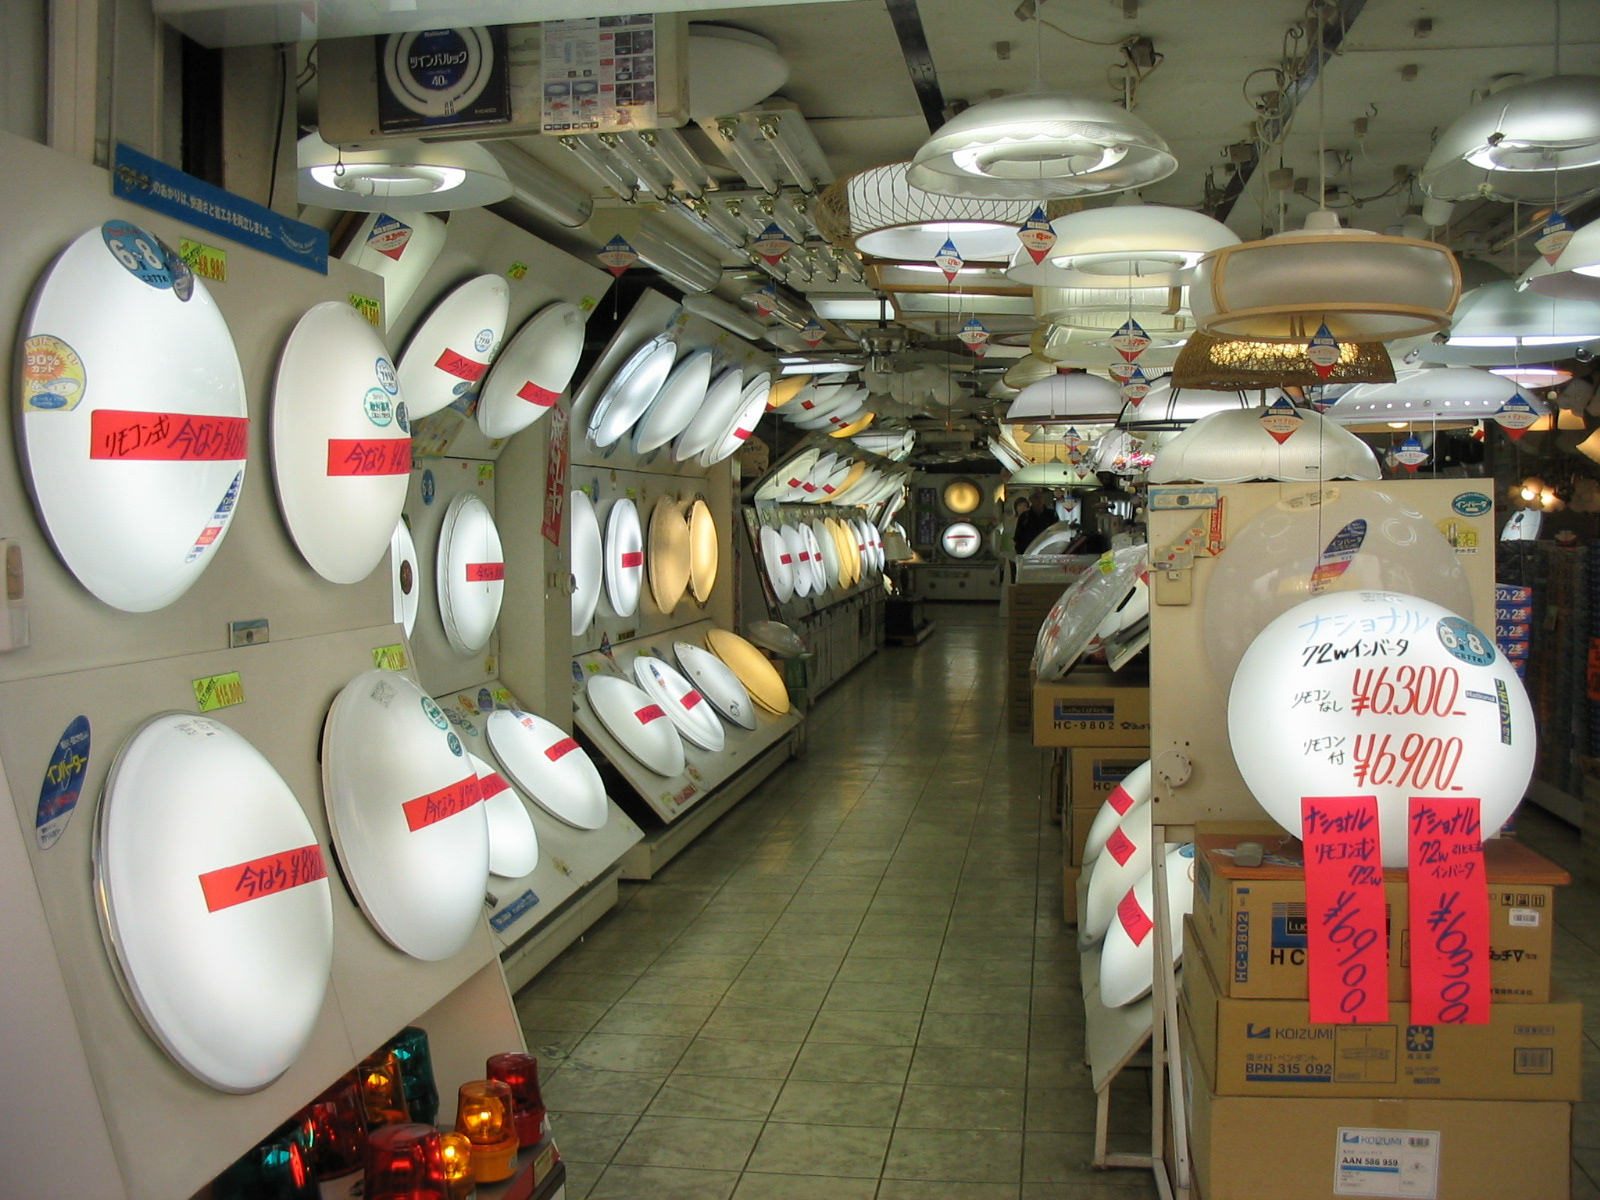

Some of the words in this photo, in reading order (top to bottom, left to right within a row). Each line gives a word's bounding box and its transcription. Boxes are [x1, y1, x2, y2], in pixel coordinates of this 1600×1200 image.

[1298, 606, 1430, 643] ナショナル
[1291, 688, 1332, 709] リモコン
[1318, 700, 1344, 713] なし
[1053, 721, 1115, 730] HC-9802
[1303, 736, 1347, 756] リモコン
[1327, 751, 1346, 766] 付
[1304, 805, 1374, 835] ナショナル
[1412, 804, 1481, 837] ナショナル
[1315, 837, 1376, 864] リモコン式
[235, 858, 288, 898] 今なら
[1431, 861, 1476, 880] インバータ
[1235, 913, 1248, 982] HC-9802
[1275, 1028, 1333, 1040] KOIZUMI
[1246, 1062, 1273, 1074] BPN
[1277, 1063, 1300, 1074] 315
[1304, 1063, 1333, 1075] 092
[1360, 1135, 1402, 1146] KOIZUMI
[1342, 1155, 1362, 1165] AAN
